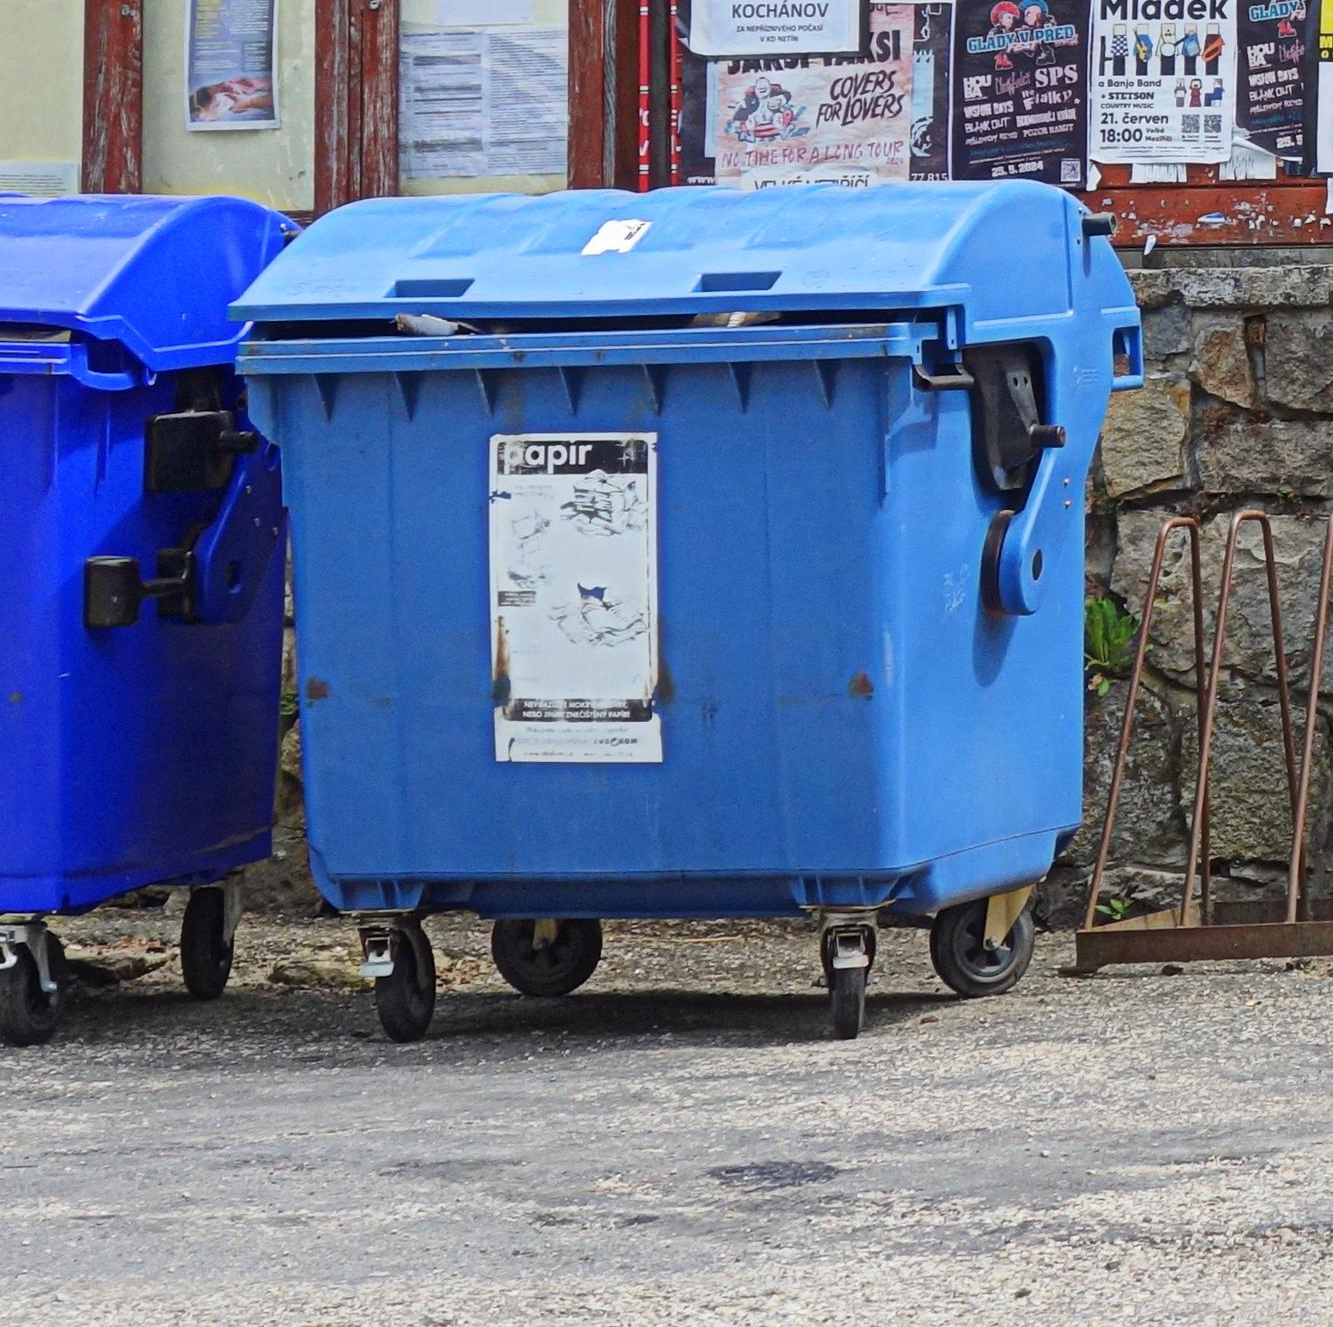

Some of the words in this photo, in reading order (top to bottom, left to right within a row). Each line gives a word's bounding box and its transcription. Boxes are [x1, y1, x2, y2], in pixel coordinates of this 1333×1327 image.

[731, 0, 830, 19] KOCHÁNOV
[736, 25, 746, 34] ZA
[798, 23, 823, 33] POČASÍ
[1033, 23, 1076, 43] PŘED
[1247, 42, 1275, 58] HOU
[1248, 55, 1267, 67] BA
[963, 74, 993, 89] HOU
[1034, 64, 1079, 88] SPS
[830, 69, 898, 101] COVERS
[1098, 80, 1105, 88] a
[1107, 79, 1135, 90] Banjo
[1137, 78, 1162, 88] Band
[1275, 84, 1295, 98] OUT
[964, 87, 984, 100] BA
[1108, 91, 1154, 100] STETSON
[816, 102, 842, 130] FOR
[841, 92, 906, 127] LOVERS
[991, 116, 1012, 128] OUT
[1101, 113, 1118, 125] 21.
[1123, 112, 1169, 125] červen
[1100, 129, 1143, 143] 18:00
[745, 150, 779, 167] TIME
[782, 147, 808, 166] FOR
[807, 146, 821, 165] A
[823, 143, 864, 162] LONG
[867, 140, 905, 158] TOUR
[1019, 160, 1045, 174] 2024
[928, 172, 949, 182] 815
